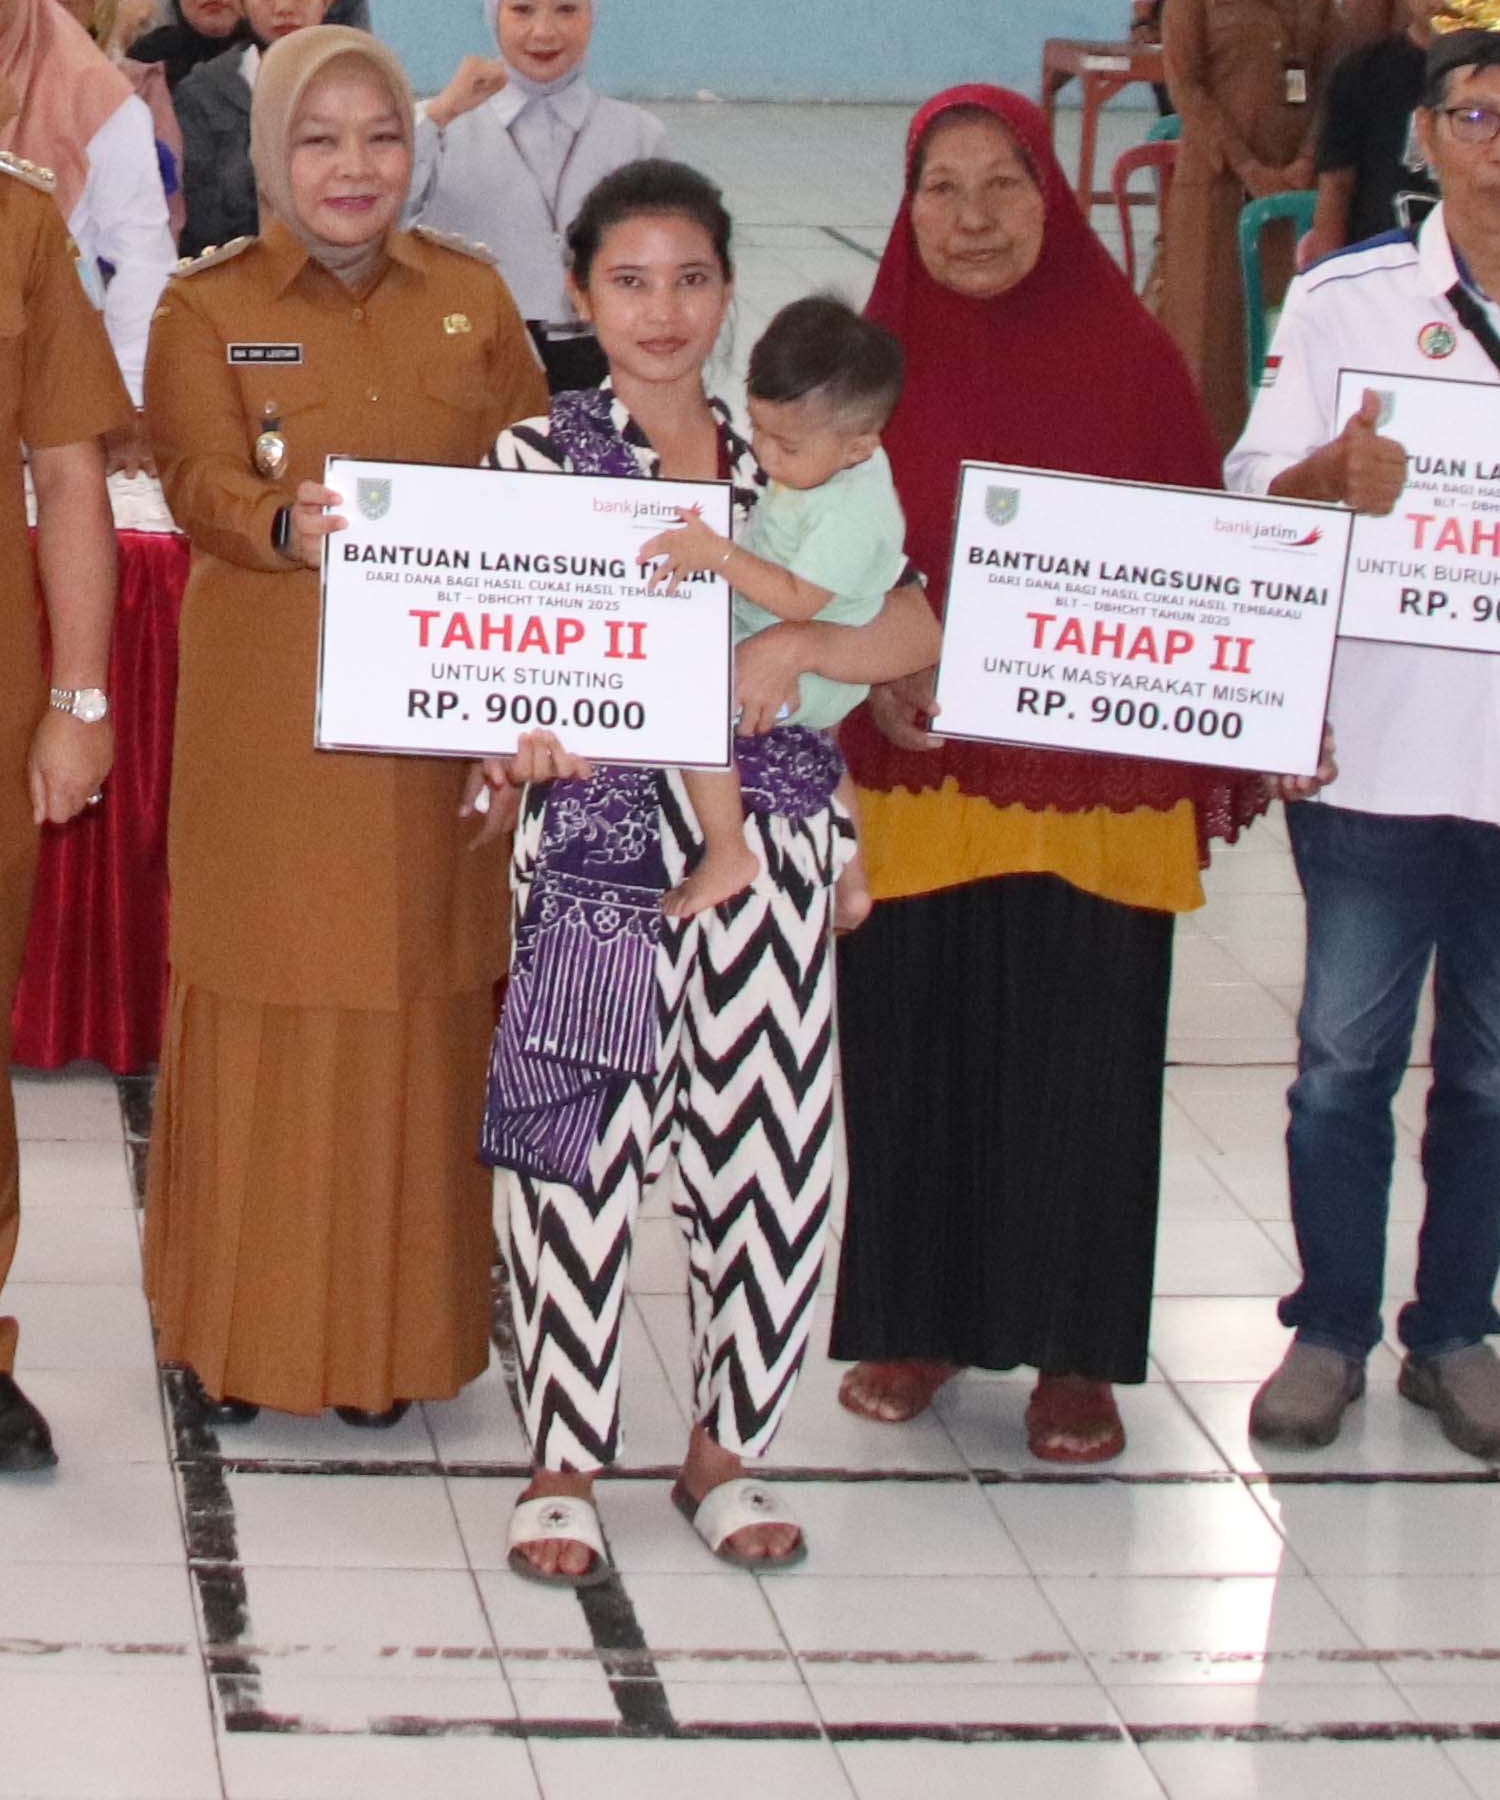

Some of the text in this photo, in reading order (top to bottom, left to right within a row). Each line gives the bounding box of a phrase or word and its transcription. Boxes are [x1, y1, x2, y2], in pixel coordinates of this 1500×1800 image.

[343, 543, 471, 569] BANTUAN
[480, 551, 627, 579] LANGSUNG
[968, 546, 1328, 606] BANTUAN LANGSUNG TUNAI
[1356, 556, 1427, 579] UNTUK
[365, 570, 401, 584] DARI
[404, 572, 442, 586] DANA
[445, 575, 479, 588] BAGI
[483, 577, 525, 591] HASIL
[529, 579, 571, 593] CUKAI
[574, 581, 614, 596] HASIL
[437, 591, 462, 603] BLT
[538, 596, 583, 609] TAHUN
[587, 599, 620, 612] 2025
[988, 573, 1302, 620] DARI DANA BAGI HASIL CUKAI HASIL TEMBAKAU
[1055, 597, 1078, 609] BLT
[1151, 607, 1195, 623] TAHUN
[1399, 587, 1458, 620] RP.
[409, 609, 649, 660] TAHAP II
[1026, 612, 1256, 674] TAHAP II
[430, 663, 623, 689] UNTUK STUNTING
[983, 657, 1285, 708] UNTUK MASYARAKAT MISKIN
[407, 689, 646, 731] RP. 900.000
[1016, 687, 1244, 739] RP. 900.000
